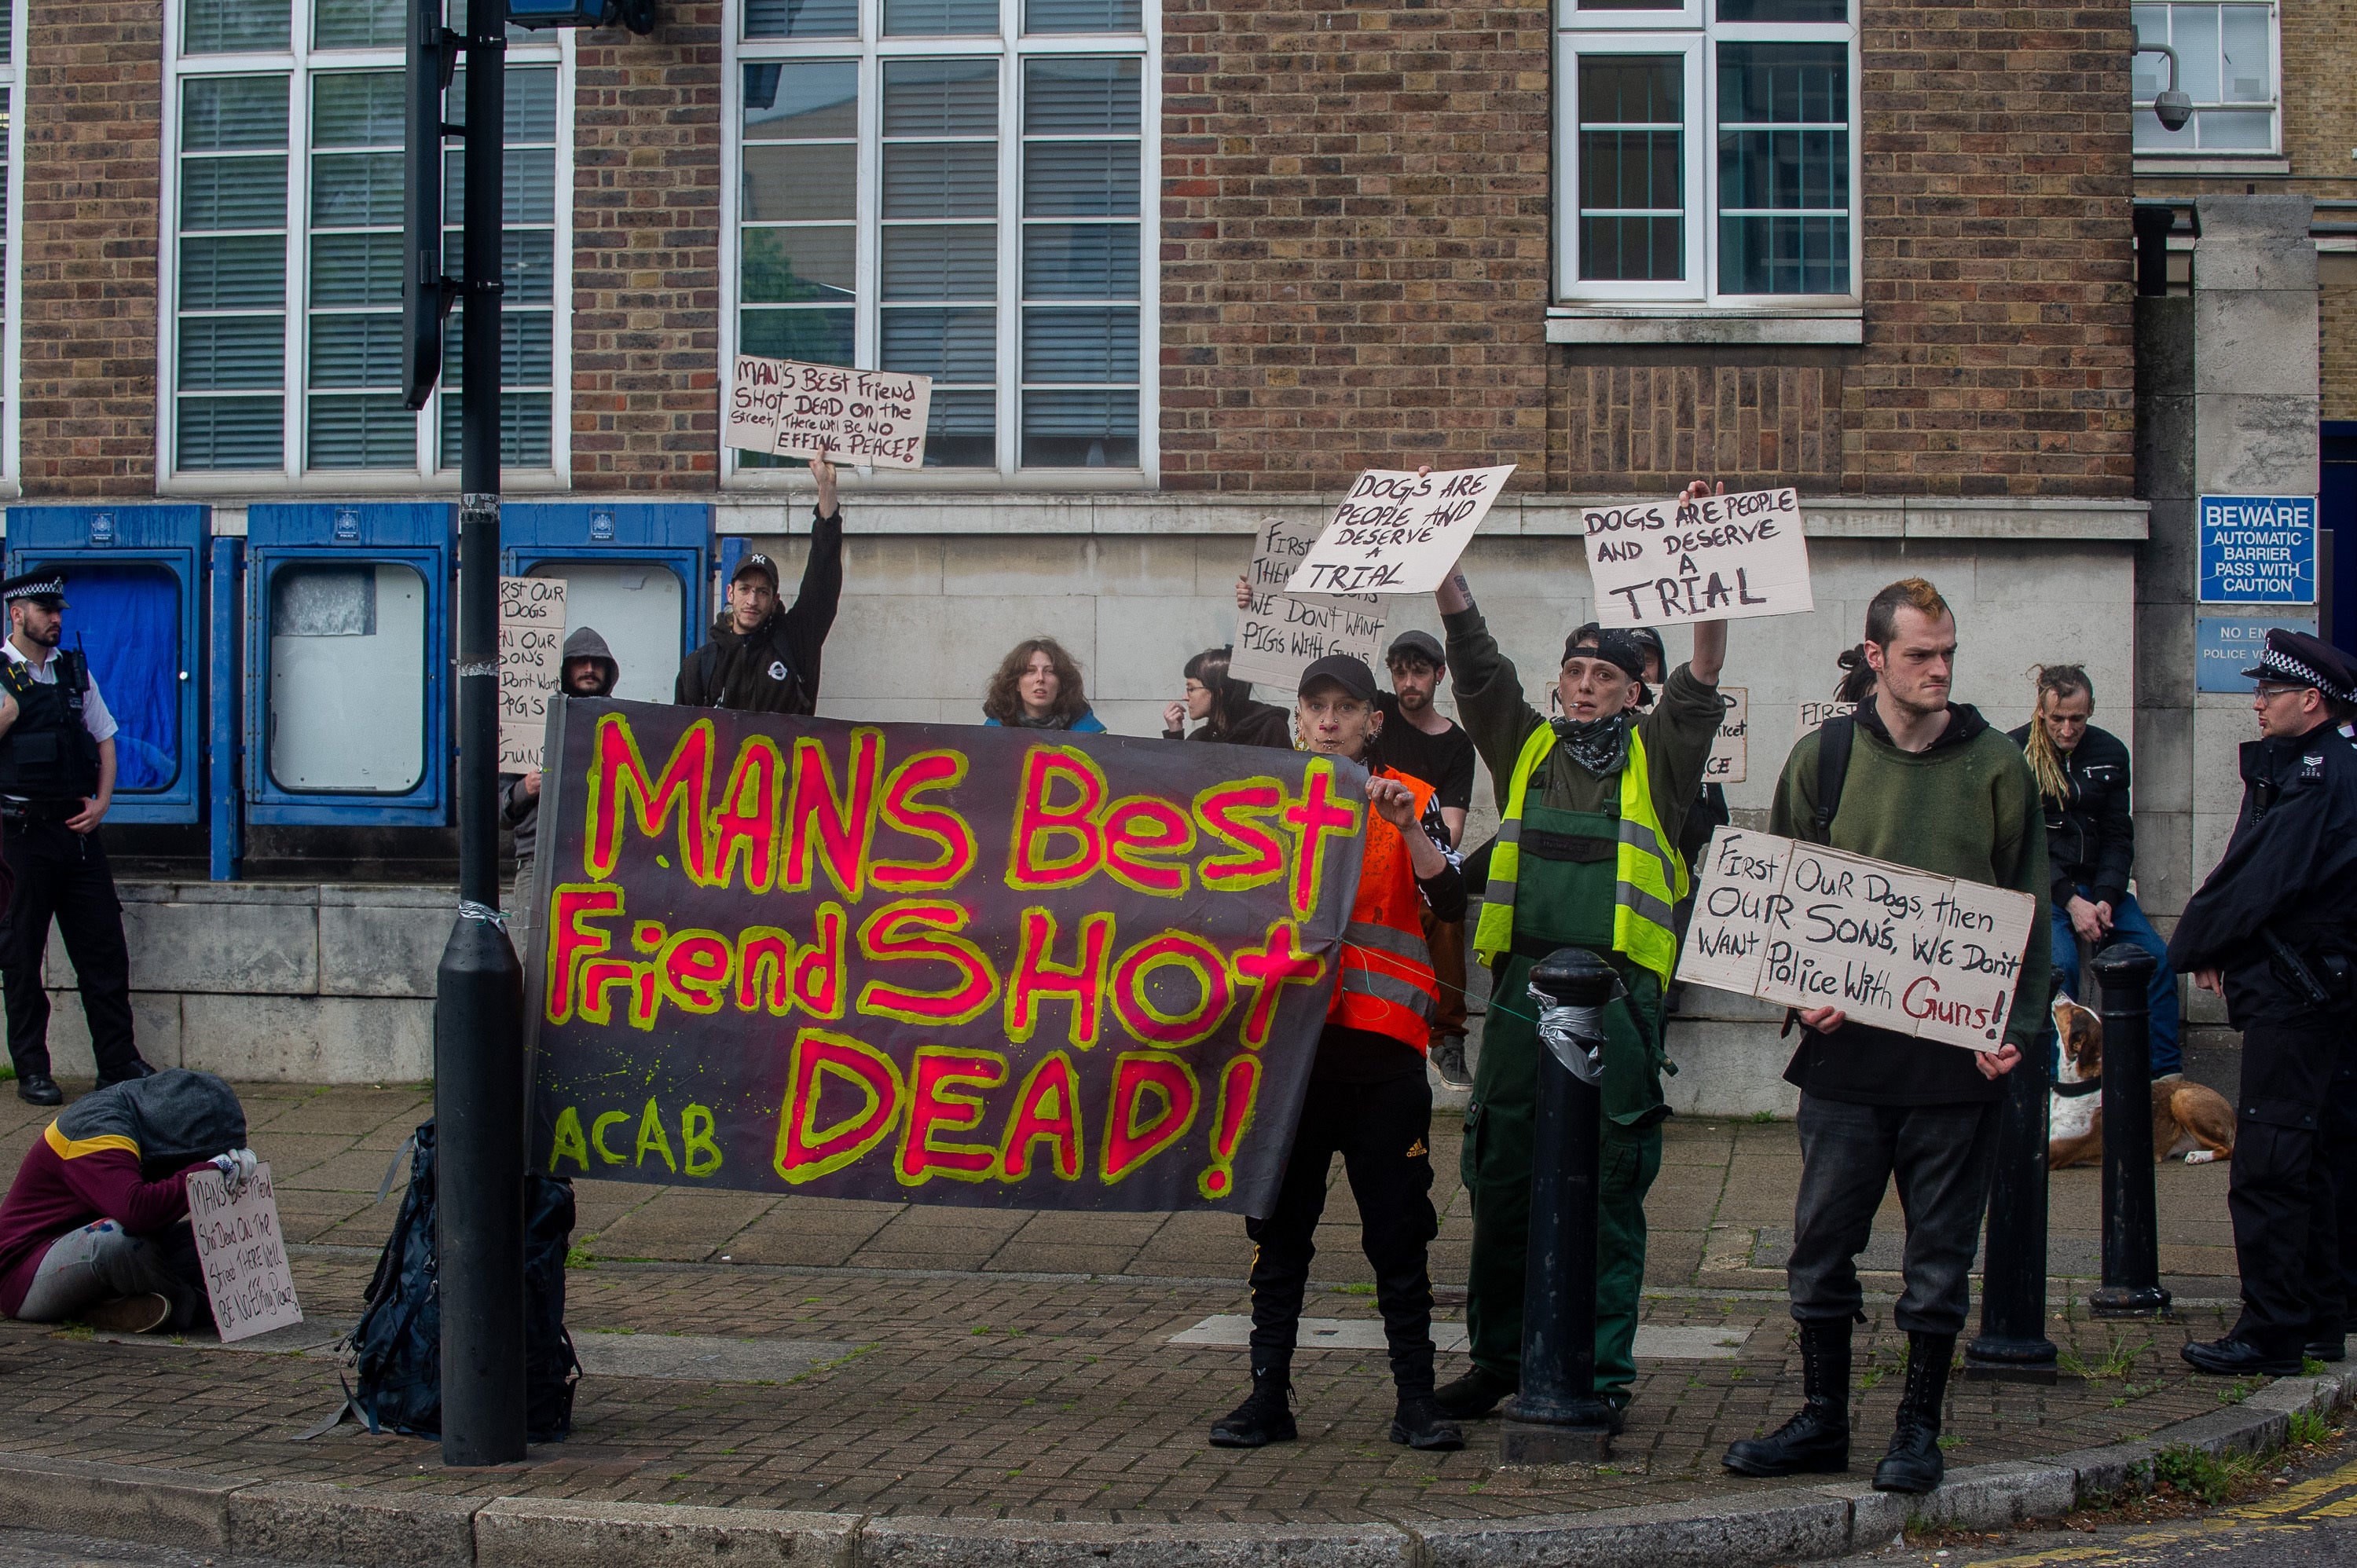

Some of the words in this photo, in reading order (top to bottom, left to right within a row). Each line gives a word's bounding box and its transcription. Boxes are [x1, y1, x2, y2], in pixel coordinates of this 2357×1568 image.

[739, 361, 796, 388] MAN'S
[794, 395, 844, 417] DEAD
[879, 402, 912, 420] the
[867, 421, 893, 436] NO
[848, 434, 920, 463] PEACE!
[1351, 474, 1433, 511] DOGS
[1439, 473, 1489, 499] ARE
[1332, 503, 1414, 527] PEOPLE
[1423, 500, 1477, 528] AND
[1584, 507, 1666, 537] DOGS
[1675, 501, 1723, 528] ARE
[1724, 490, 1797, 521] PEOPLE
[2206, 505, 2309, 528] BEWARE
[1334, 526, 1435, 546] DESERVE
[1597, 540, 1644, 562] AND
[1663, 518, 1781, 555] DESERVE
[2213, 531, 2303, 547] AUTOMATIC
[1365, 546, 1383, 559] A
[1678, 552, 1698, 576] A
[2224, 548, 2291, 561] BARRIER
[1310, 562, 1406, 591] TRIAL
[2215, 562, 2255, 577] PASS
[2260, 563, 2300, 577] WITH
[1609, 567, 1768, 621] TRIAL
[2223, 578, 2293, 592] CAUTION
[502, 599, 548, 618] DOGS
[2220, 627, 2241, 638] NO
[2204, 649, 2246, 659] POLICE
[1801, 702, 1857, 725] FIRST
[585, 712, 979, 904] MANS
[1004, 743, 1363, 924] Best
[1864, 874, 1926, 921] Dogs,
[1931, 892, 1994, 933] then
[1766, 940, 1838, 995] Police
[1902, 976, 2007, 1040] Guns!
[774, 1027, 1263, 1200] DEAD!
[550, 1097, 723, 1178] ACAB
